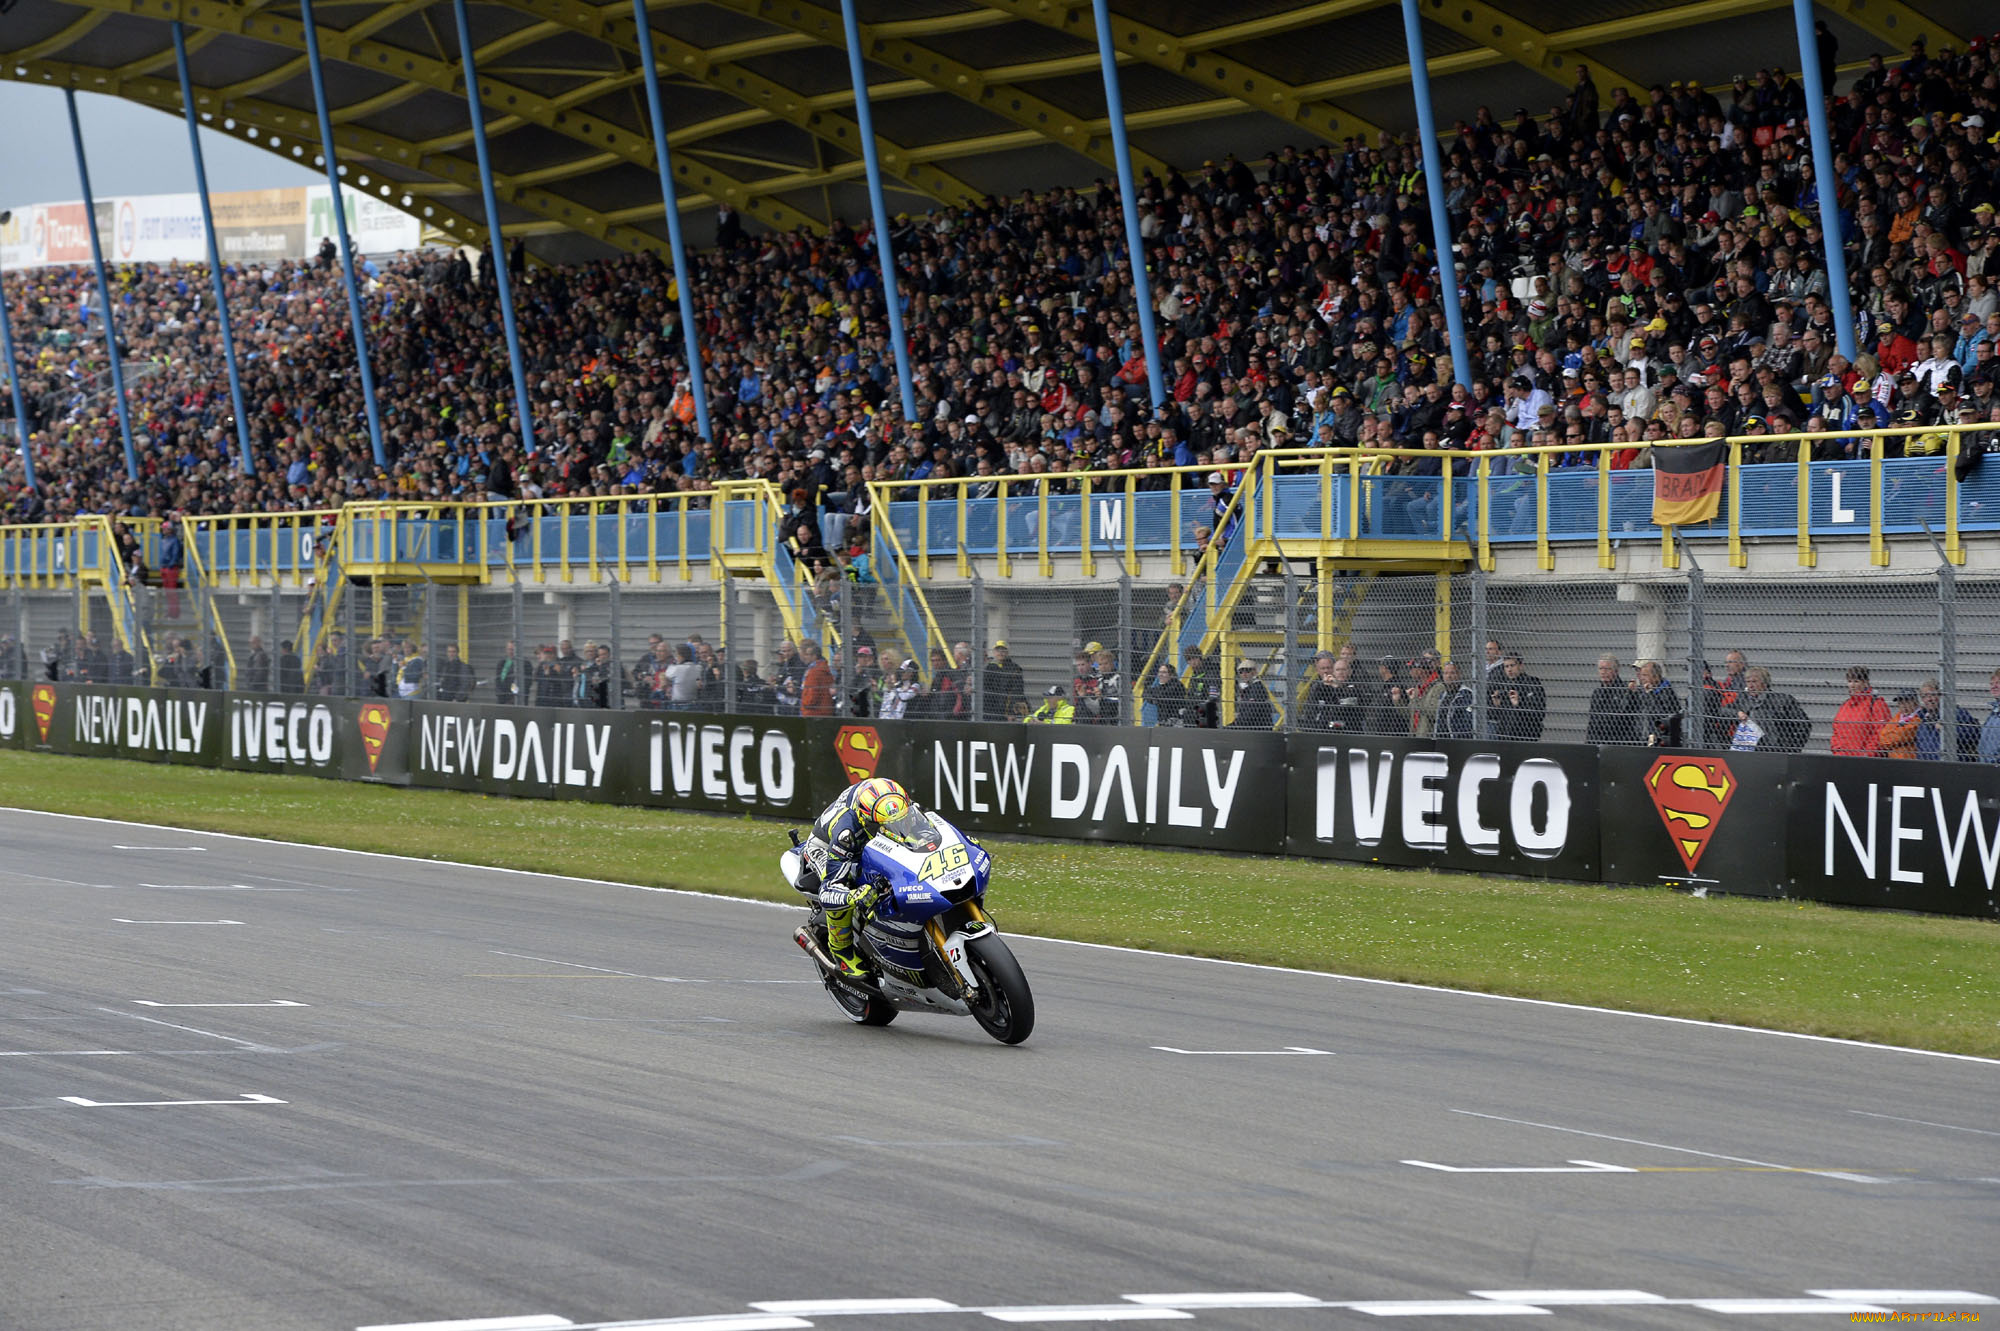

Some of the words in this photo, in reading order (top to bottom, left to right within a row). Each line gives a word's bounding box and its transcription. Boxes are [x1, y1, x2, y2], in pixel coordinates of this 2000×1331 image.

[1099, 499, 1122, 540] M
[1831, 471, 1856, 523] L
[76, 695, 122, 745] NEW
[127, 697, 207, 753] DAILY
[232, 699, 333, 767] IVECO
[420, 714, 486, 776] NEW
[493, 719, 612, 787] DAILY
[650, 720, 795, 807] IVECO
[934, 740, 1035, 816] NEW
[1051, 743, 1246, 829] DAILY
[1316, 746, 1571, 861] IVECO
[917, 842, 970, 884] 46
[1825, 781, 2000, 890] NEW
[898, 884, 924, 893] IVECO
